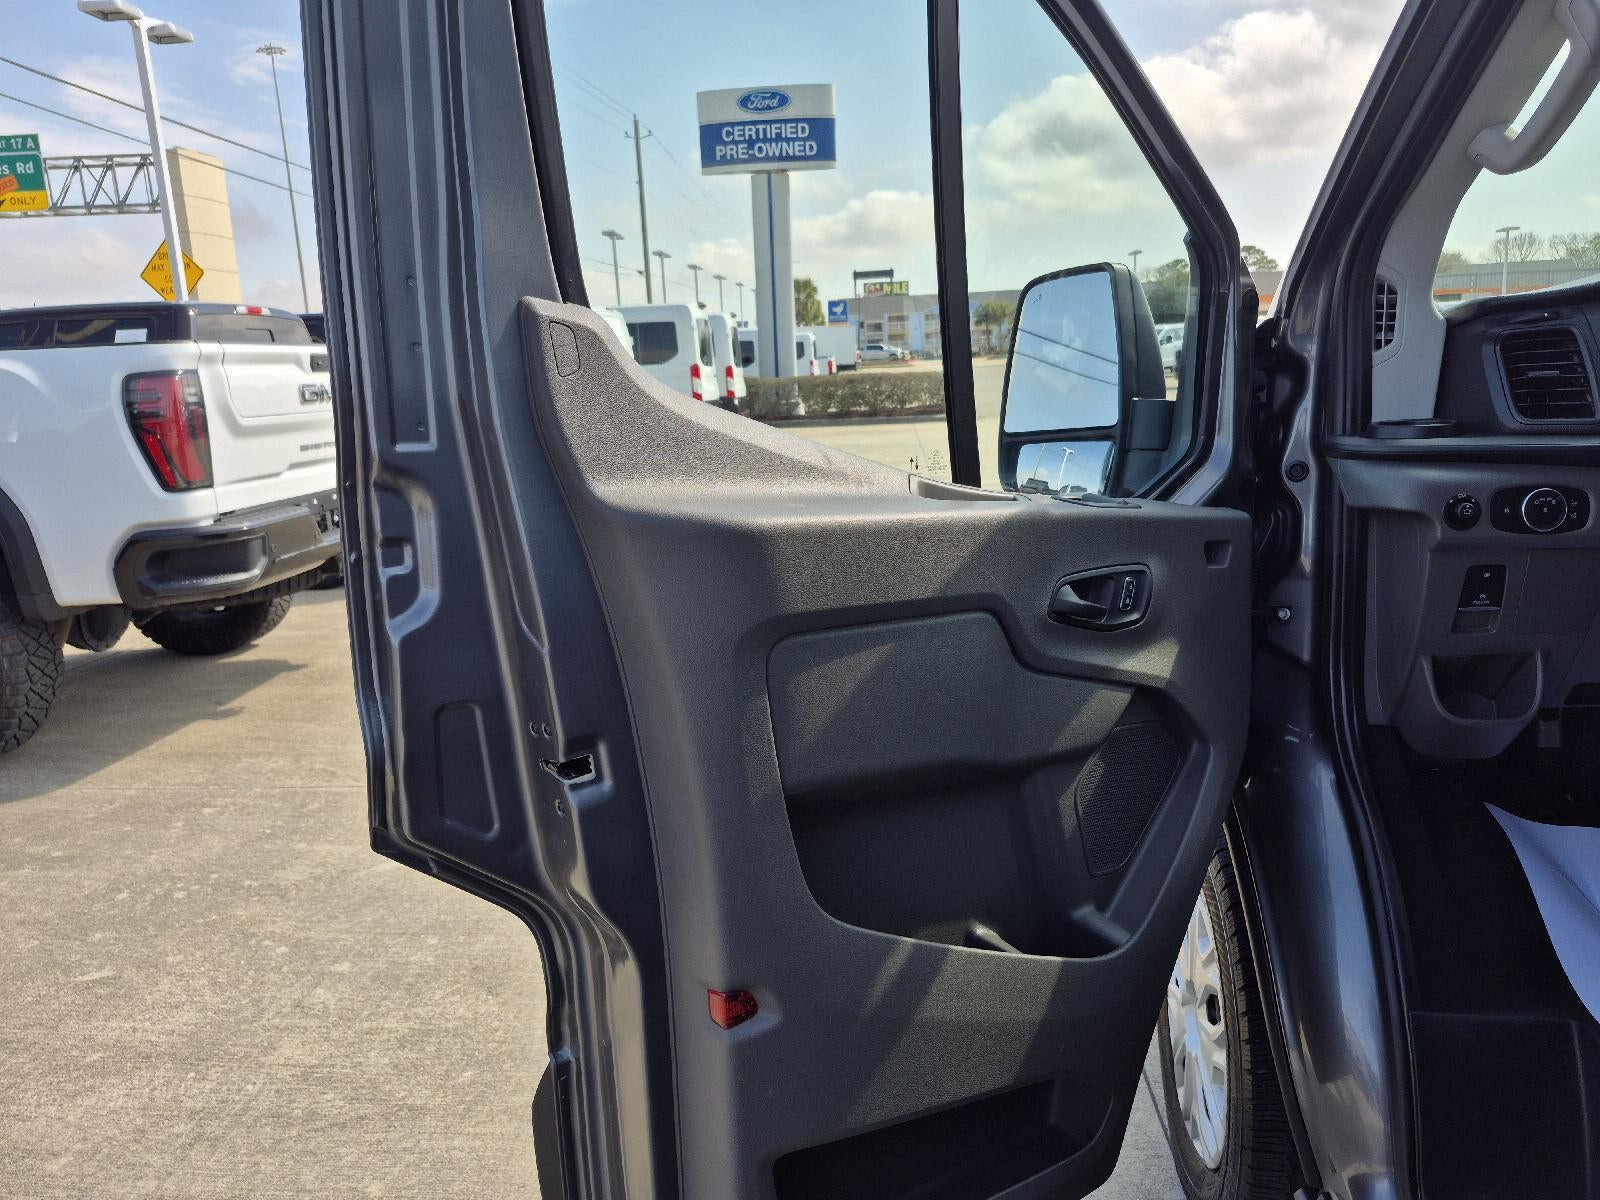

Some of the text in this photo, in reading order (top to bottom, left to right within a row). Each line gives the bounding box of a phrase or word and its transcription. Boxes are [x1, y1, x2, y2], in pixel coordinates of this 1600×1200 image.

[747, 91, 780, 109] Ford
[721, 123, 810, 142] CERTIFIED
[10, 138, 22, 149] 17
[26, 137, 35, 149] A
[715, 141, 817, 160] PRE-OWNED
[16, 160, 35, 174] Rd
[9, 196, 36, 206] ONLY
[298, 383, 332, 404] GM
